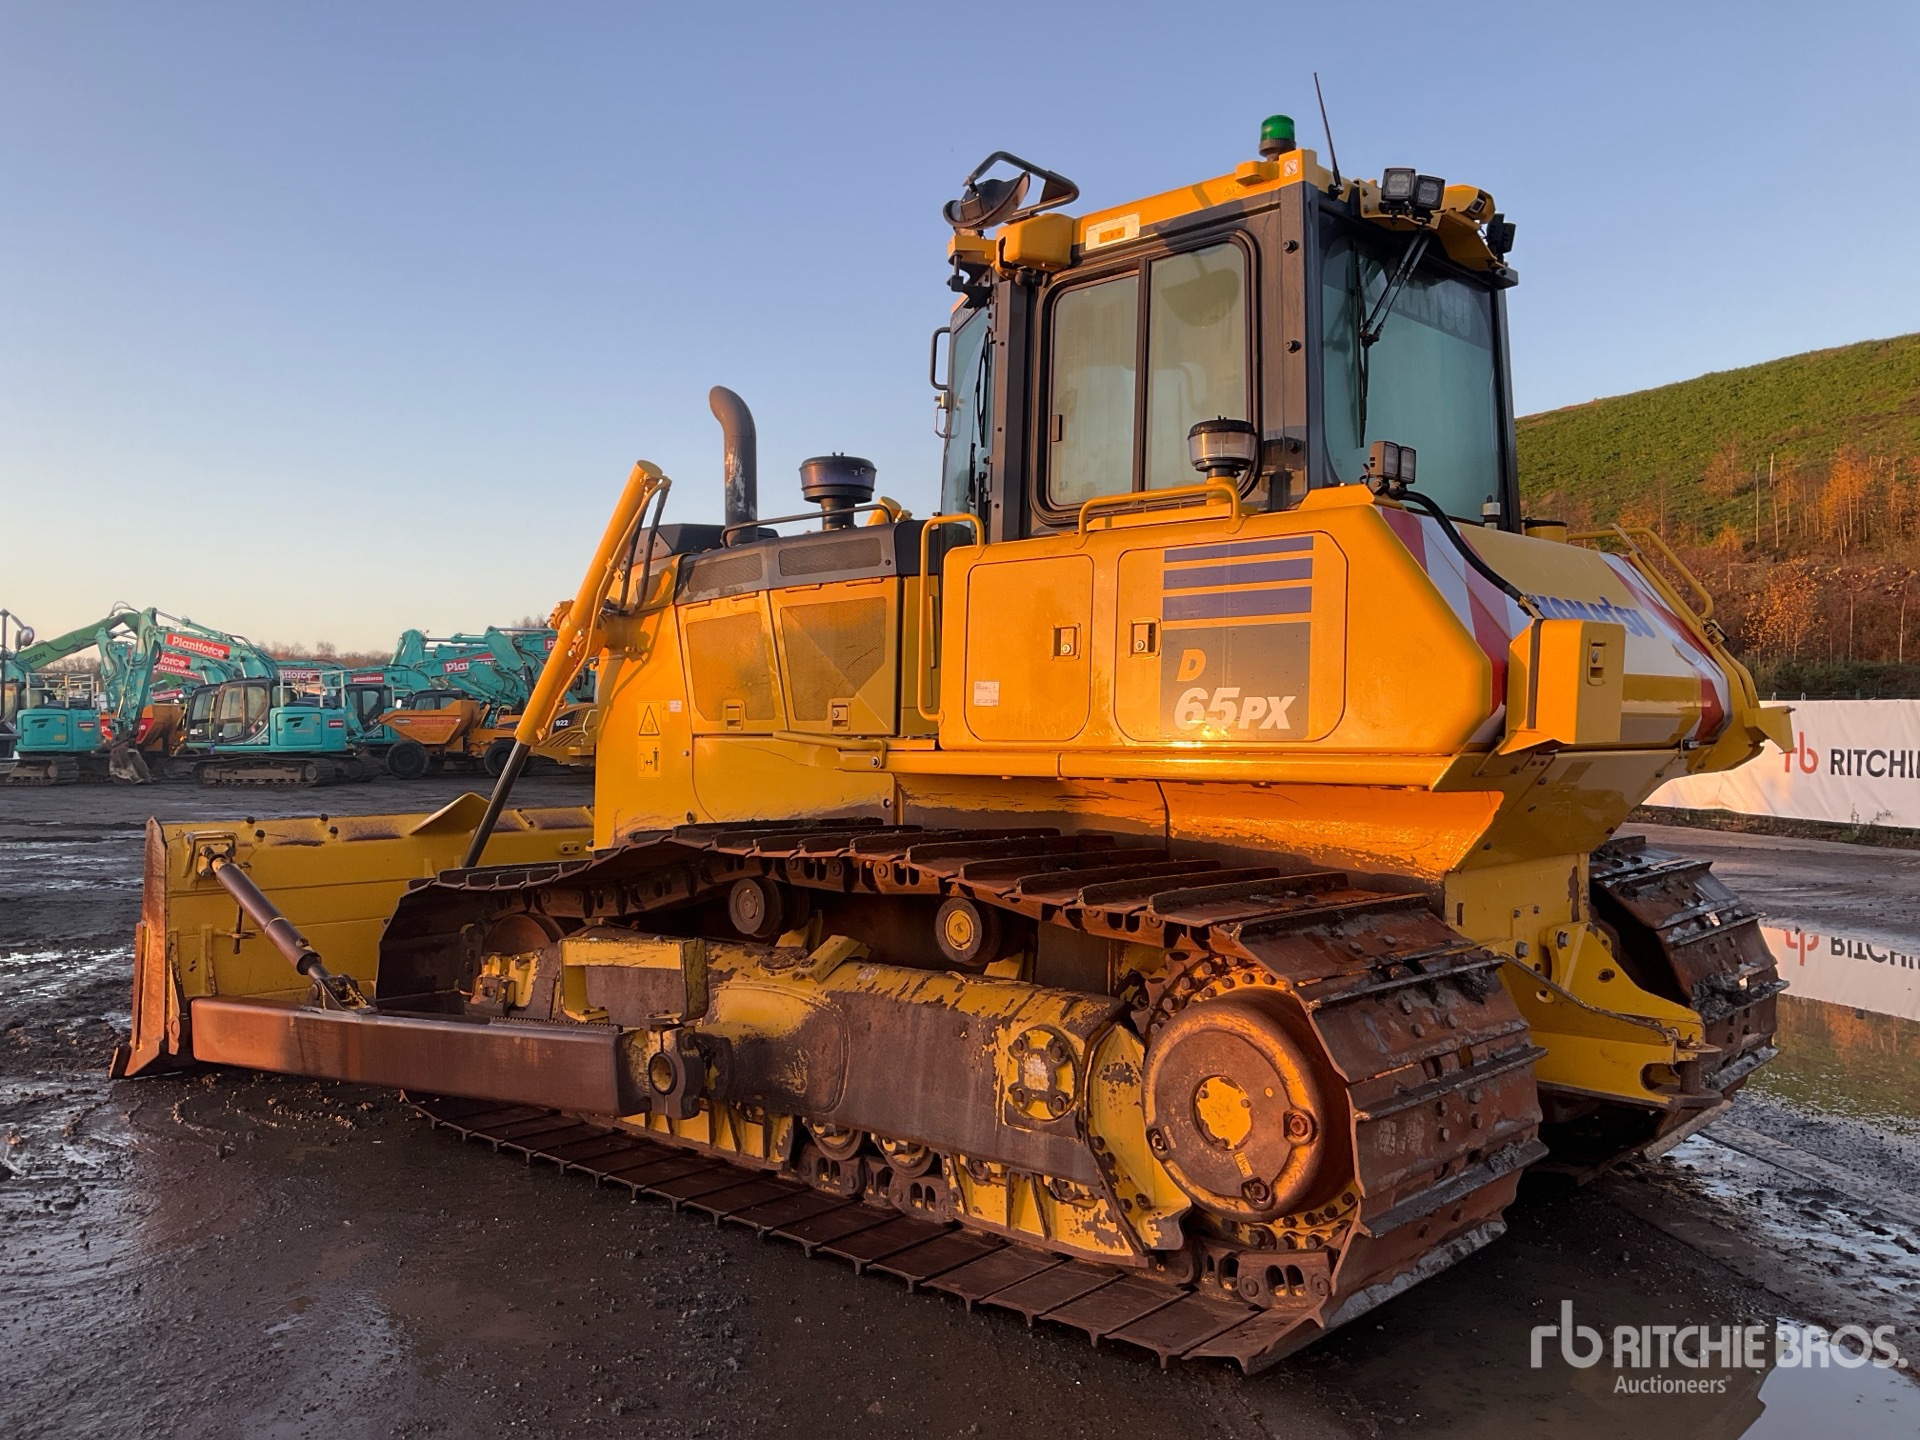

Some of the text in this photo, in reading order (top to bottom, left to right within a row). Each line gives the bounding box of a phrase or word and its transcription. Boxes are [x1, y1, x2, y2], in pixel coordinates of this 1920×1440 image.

[1176, 649, 1207, 682] D
[555, 719, 569, 727] 922
[1174, 687, 1296, 731] 65PX
[1830, 748, 1920, 778] RITCHI
